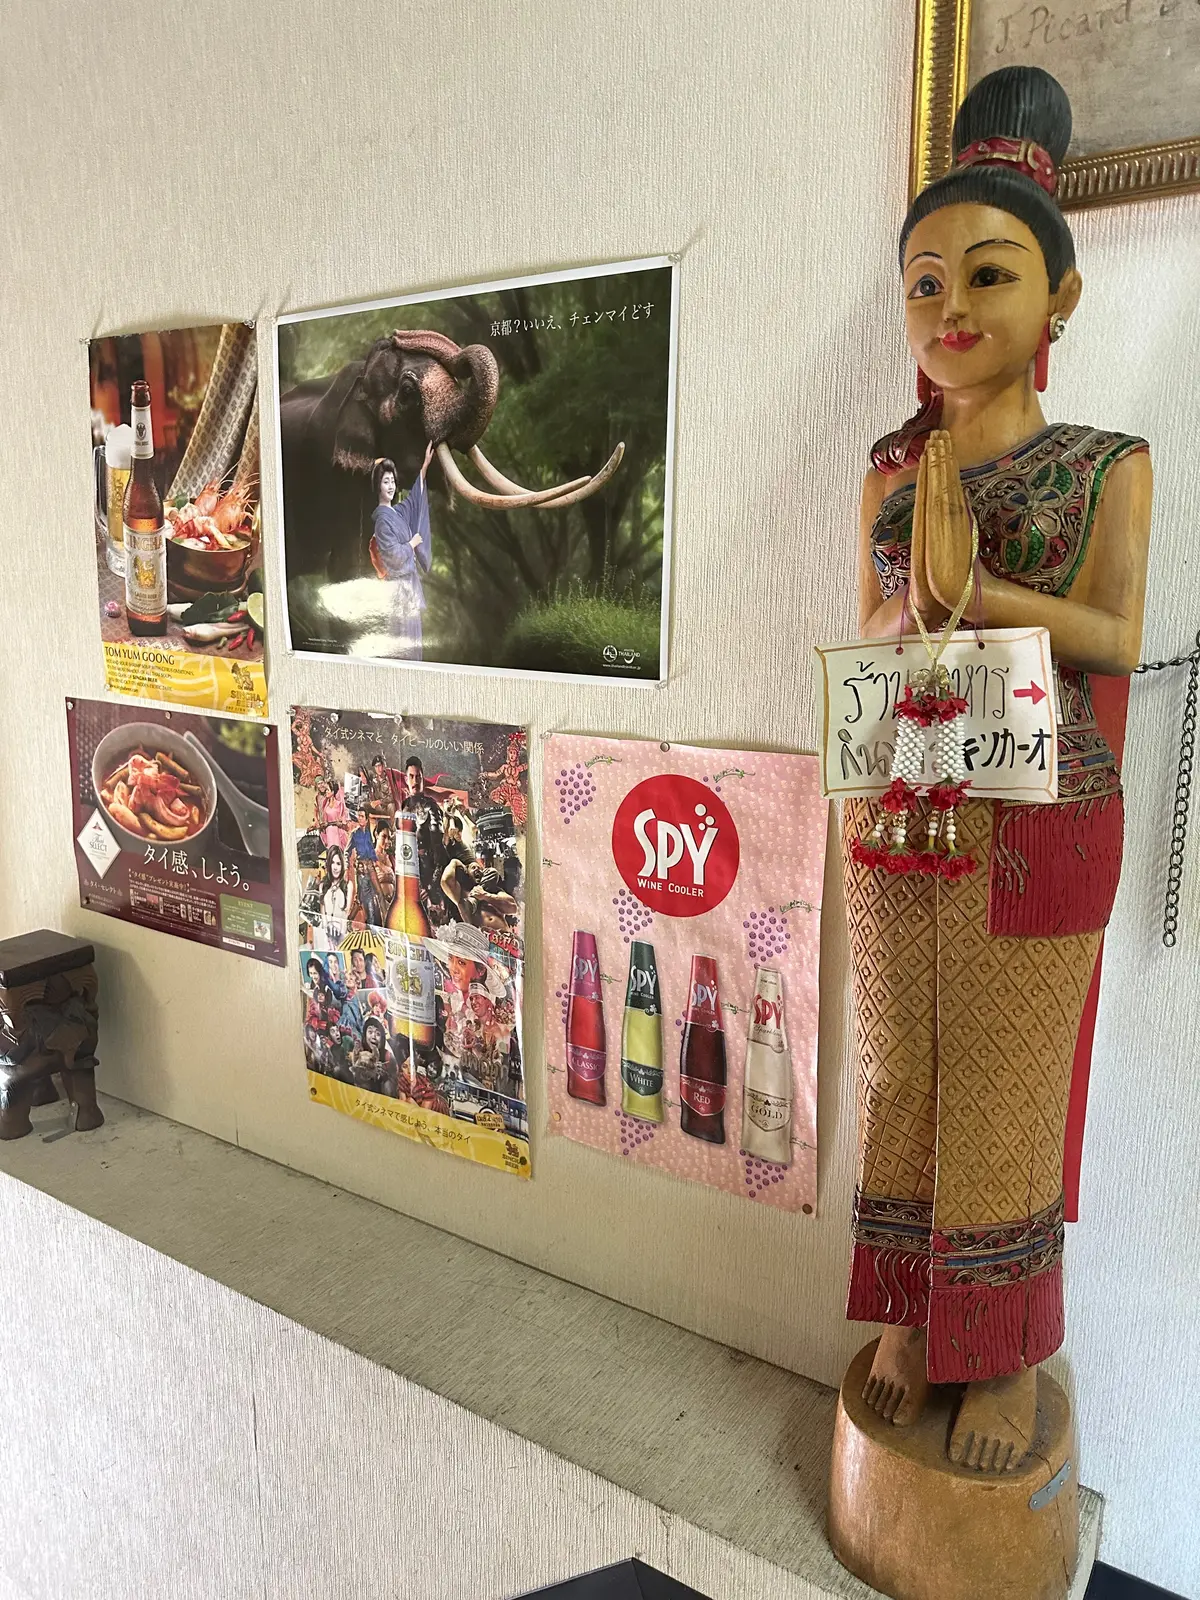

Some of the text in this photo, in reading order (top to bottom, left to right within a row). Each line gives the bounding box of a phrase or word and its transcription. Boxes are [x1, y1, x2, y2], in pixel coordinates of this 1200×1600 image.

[490, 302, 655, 337] 京都？いいえ、チェンマイどす
[105, 646, 175, 665] TOM YUM GOONG
[230, 690, 261, 702] SINGHA
[89, 842, 108, 852] SELECT
[633, 807, 719, 886] SPY
[144, 844, 250, 892] タイ感、しよう。
[573, 954, 598, 982] SPY
[631, 965, 656, 995] SPY
[691, 980, 718, 1012] SPY
[753, 994, 782, 1029] SPY
[750, 1104, 783, 1119] GOLD
[502, 1153, 521, 1164] SINGH
